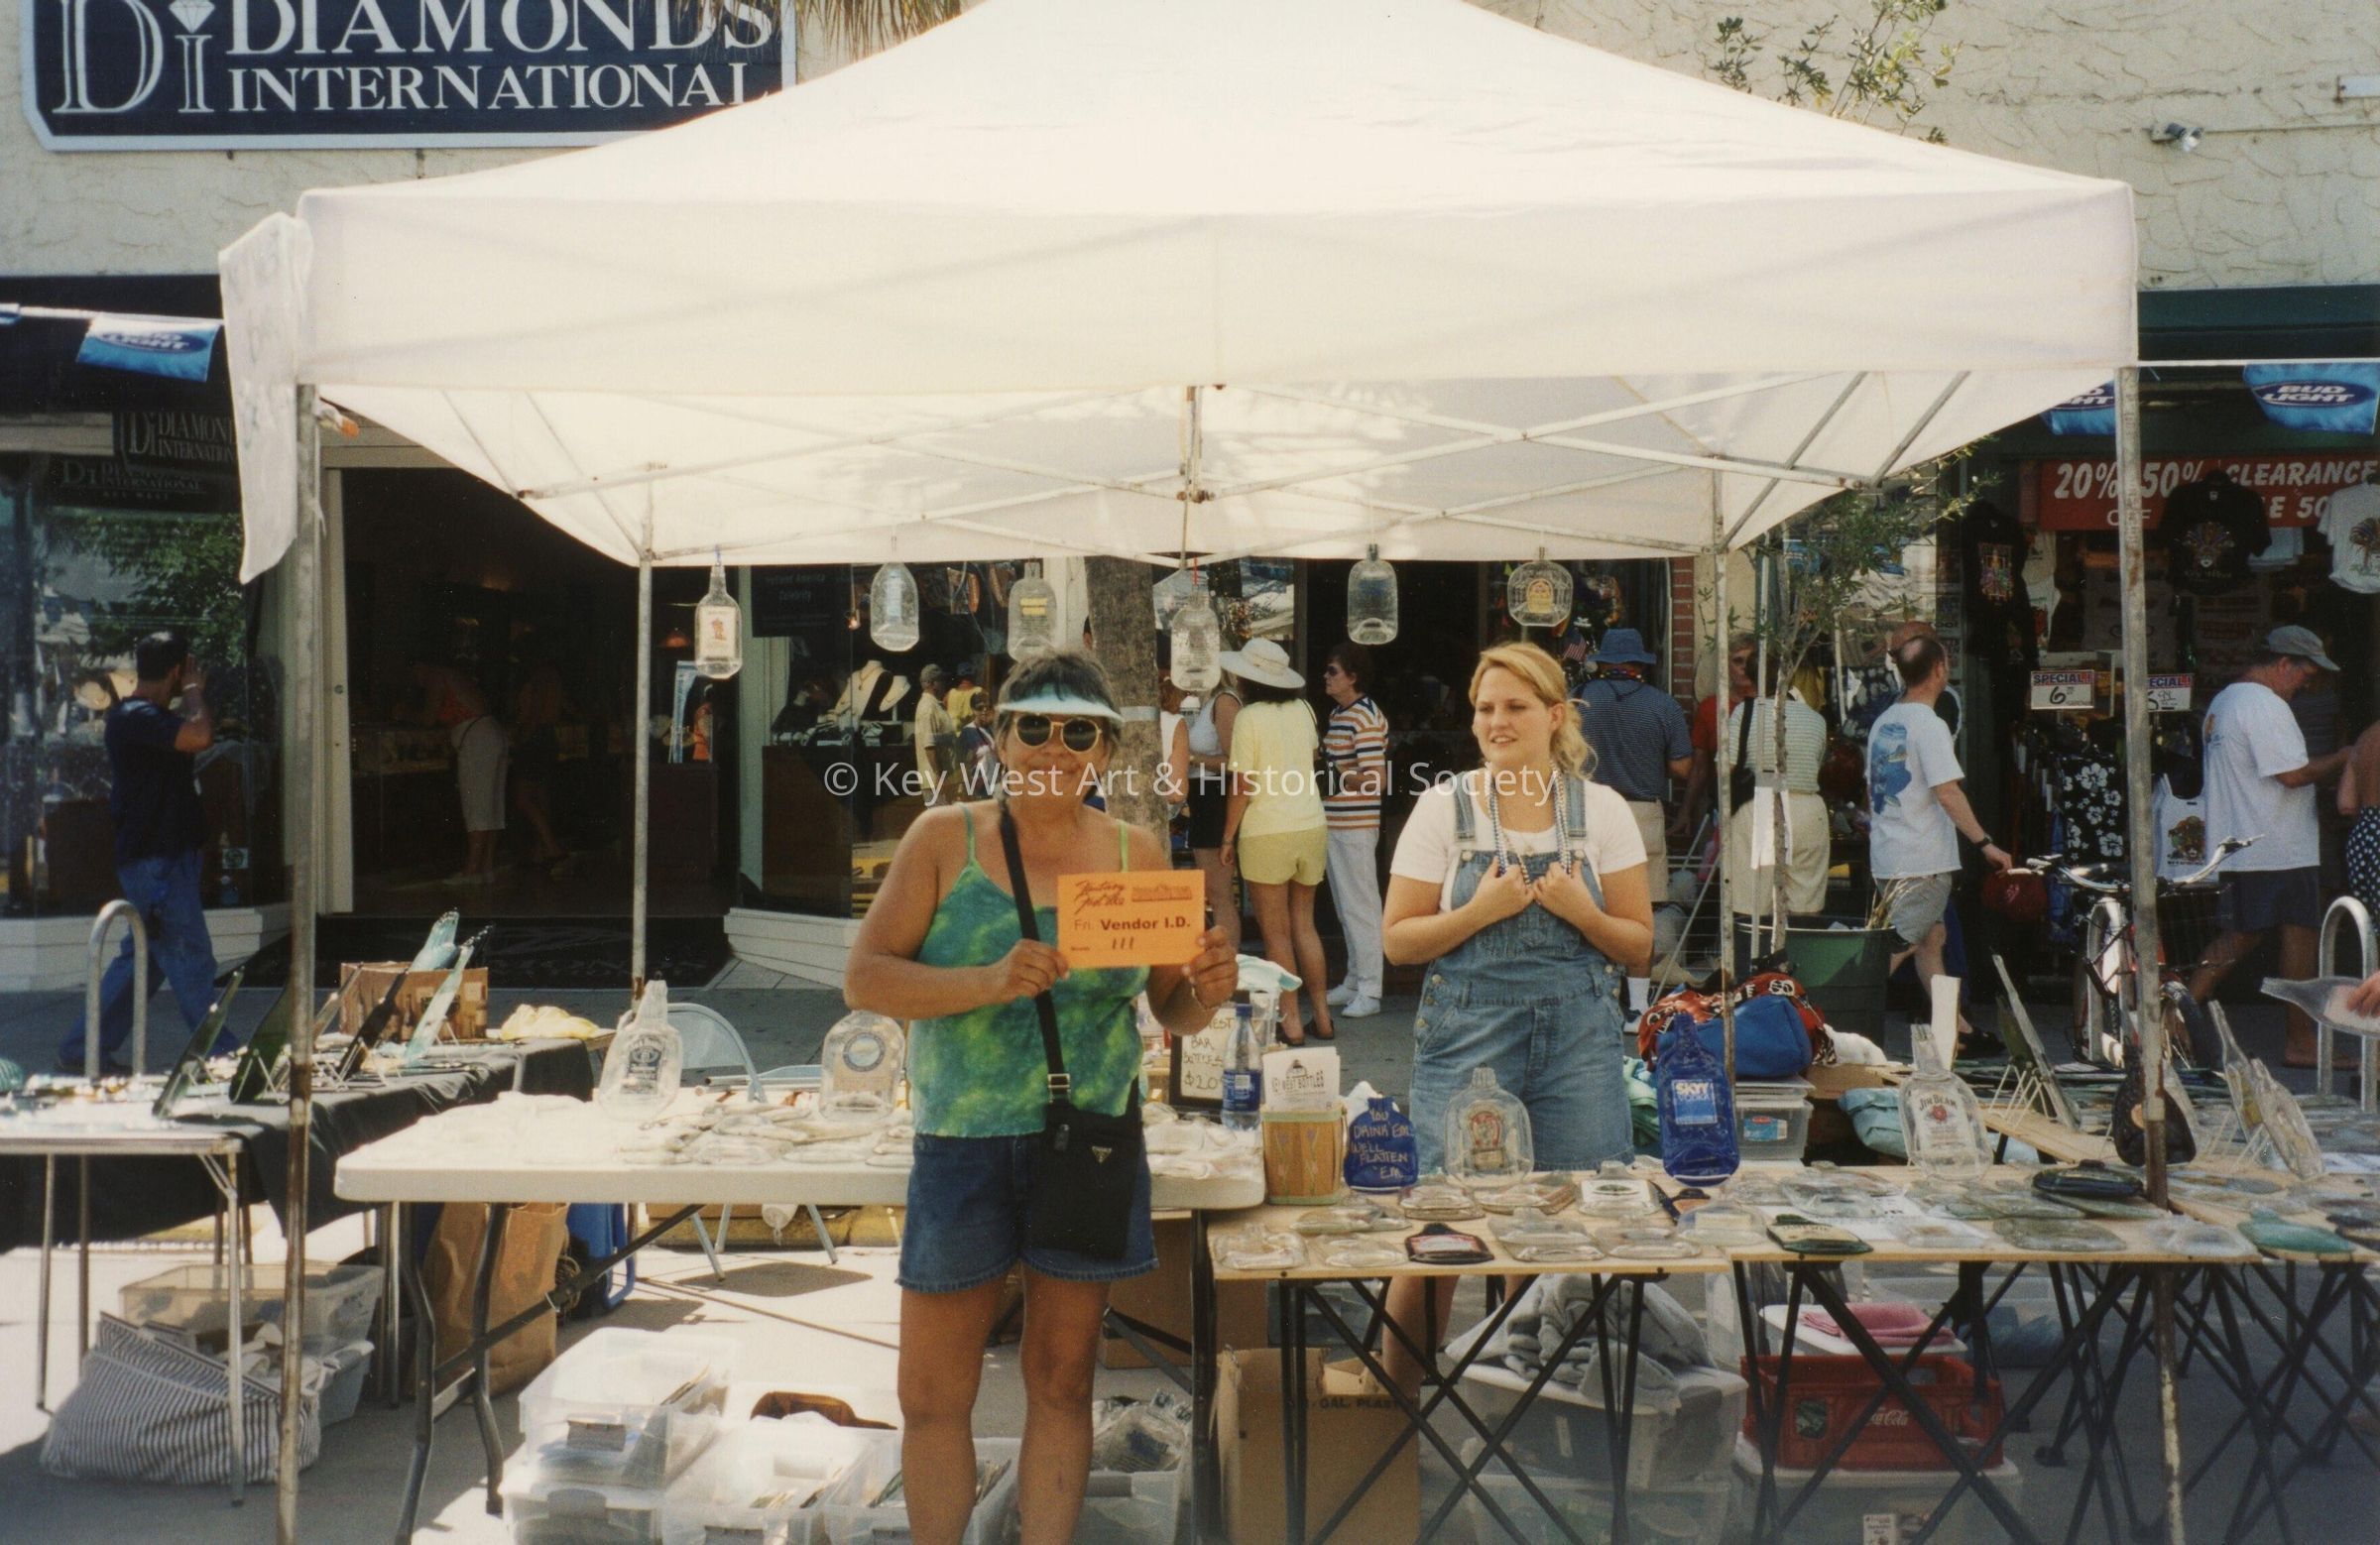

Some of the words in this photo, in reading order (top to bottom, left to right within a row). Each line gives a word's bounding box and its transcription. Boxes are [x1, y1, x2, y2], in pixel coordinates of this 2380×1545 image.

[226, 0, 773, 55] DIAMONDS
[228, 63, 769, 111] INTERNATIONAL
[2278, 385, 2346, 394] BUD
[2261, 394, 2356, 404] LIGHT
[158, 412, 232, 444] DIAMON
[158, 439, 235, 462] INTERNATION
[2226, 459, 2380, 487] CLEARANCE
[2107, 509, 2152, 527] OF
[1101, 918, 1158, 931] Vendor
[1164, 915, 1190, 929] I.D.
[1209, 1017, 1236, 1030] EST
[1191, 1035, 1215, 1050] BAR
[1369, 1109, 1388, 1122] YOU
[1360, 1151, 1409, 1166] FLATTEN
